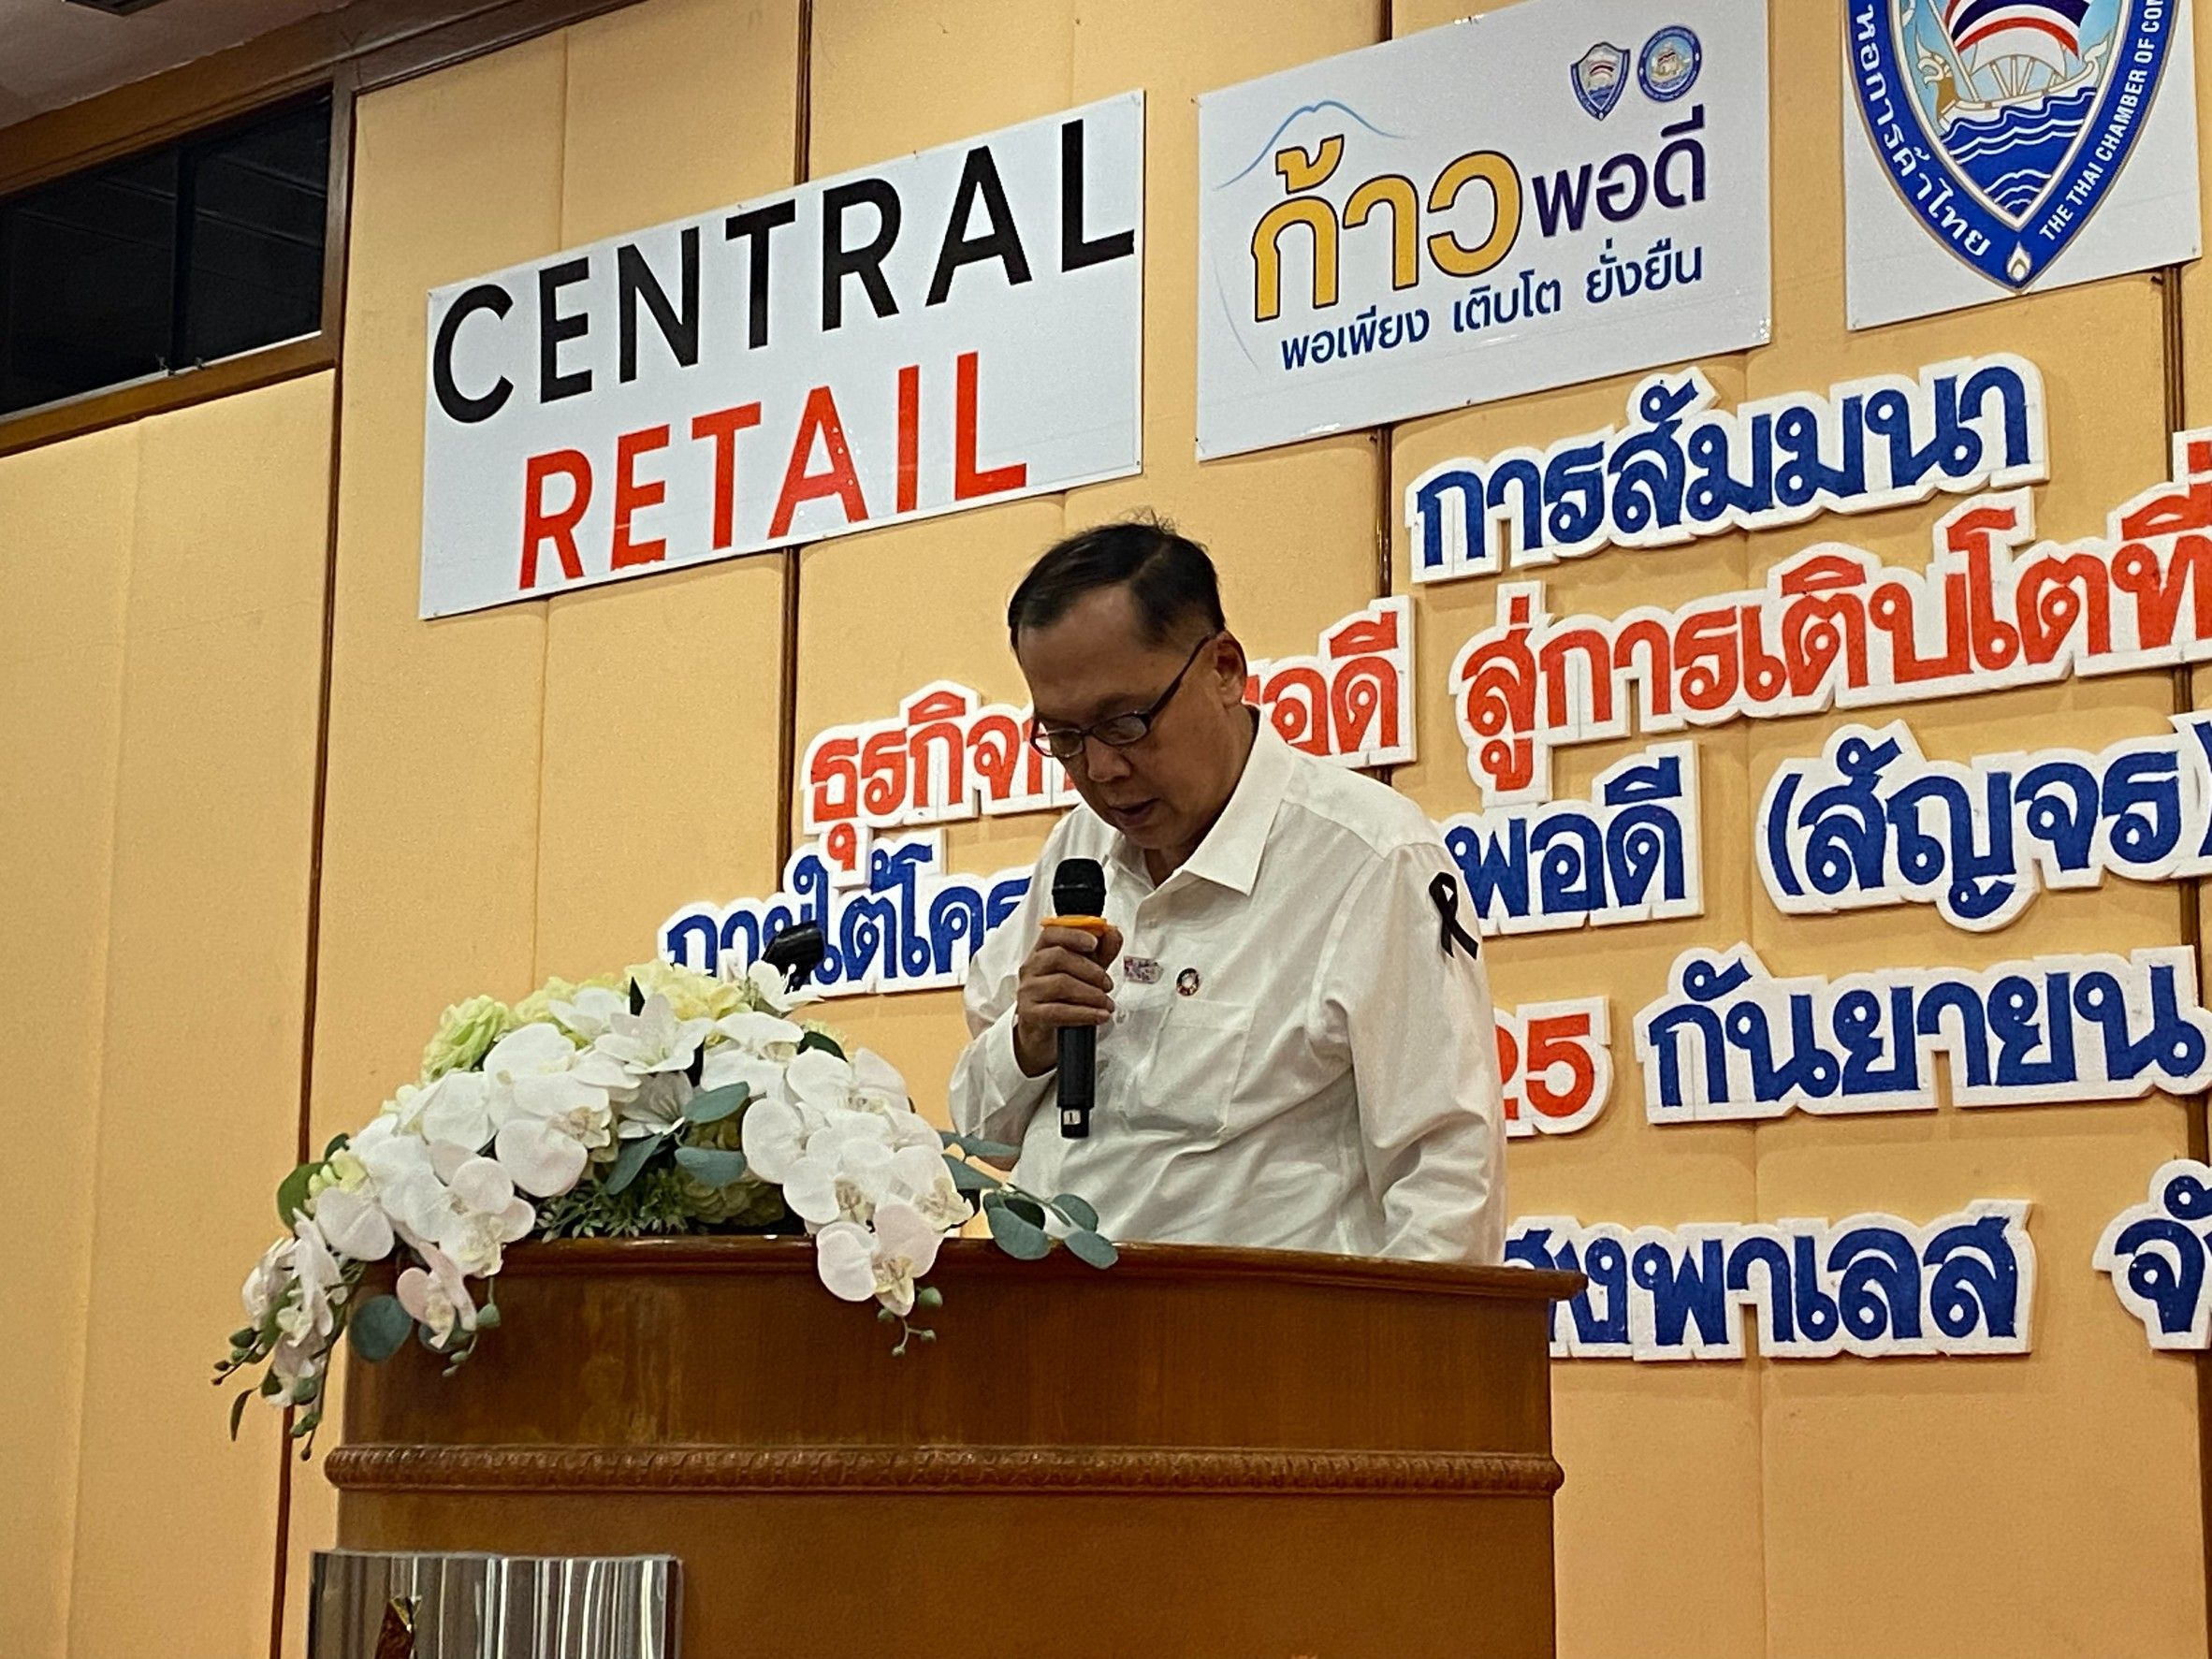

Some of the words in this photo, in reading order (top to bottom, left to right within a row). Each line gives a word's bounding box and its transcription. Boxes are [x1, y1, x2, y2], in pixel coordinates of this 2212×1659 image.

[1855, 4, 1992, 257] หอการค้าไทย
[2038, 203, 2074, 240] THE
[2065, 161, 2104, 206] THAI
[2094, 69, 2148, 162] CHAMBER
[2133, 37, 2155, 64] OF
[433, 118, 1135, 424] CENTRAL
[1281, 304, 1430, 371] พอเพียง
[1452, 269, 1561, 334] เติบโต
[1586, 238, 1703, 304] ยั่งยืน
[519, 352, 1026, 589] RETAIL
[1417, 366, 2030, 567] การสัมมนา
[1244, 611, 1399, 757] อดี
[1648, 959, 2207, 1107] กันยายน
[2114, 1175, 2212, 1334] จั
